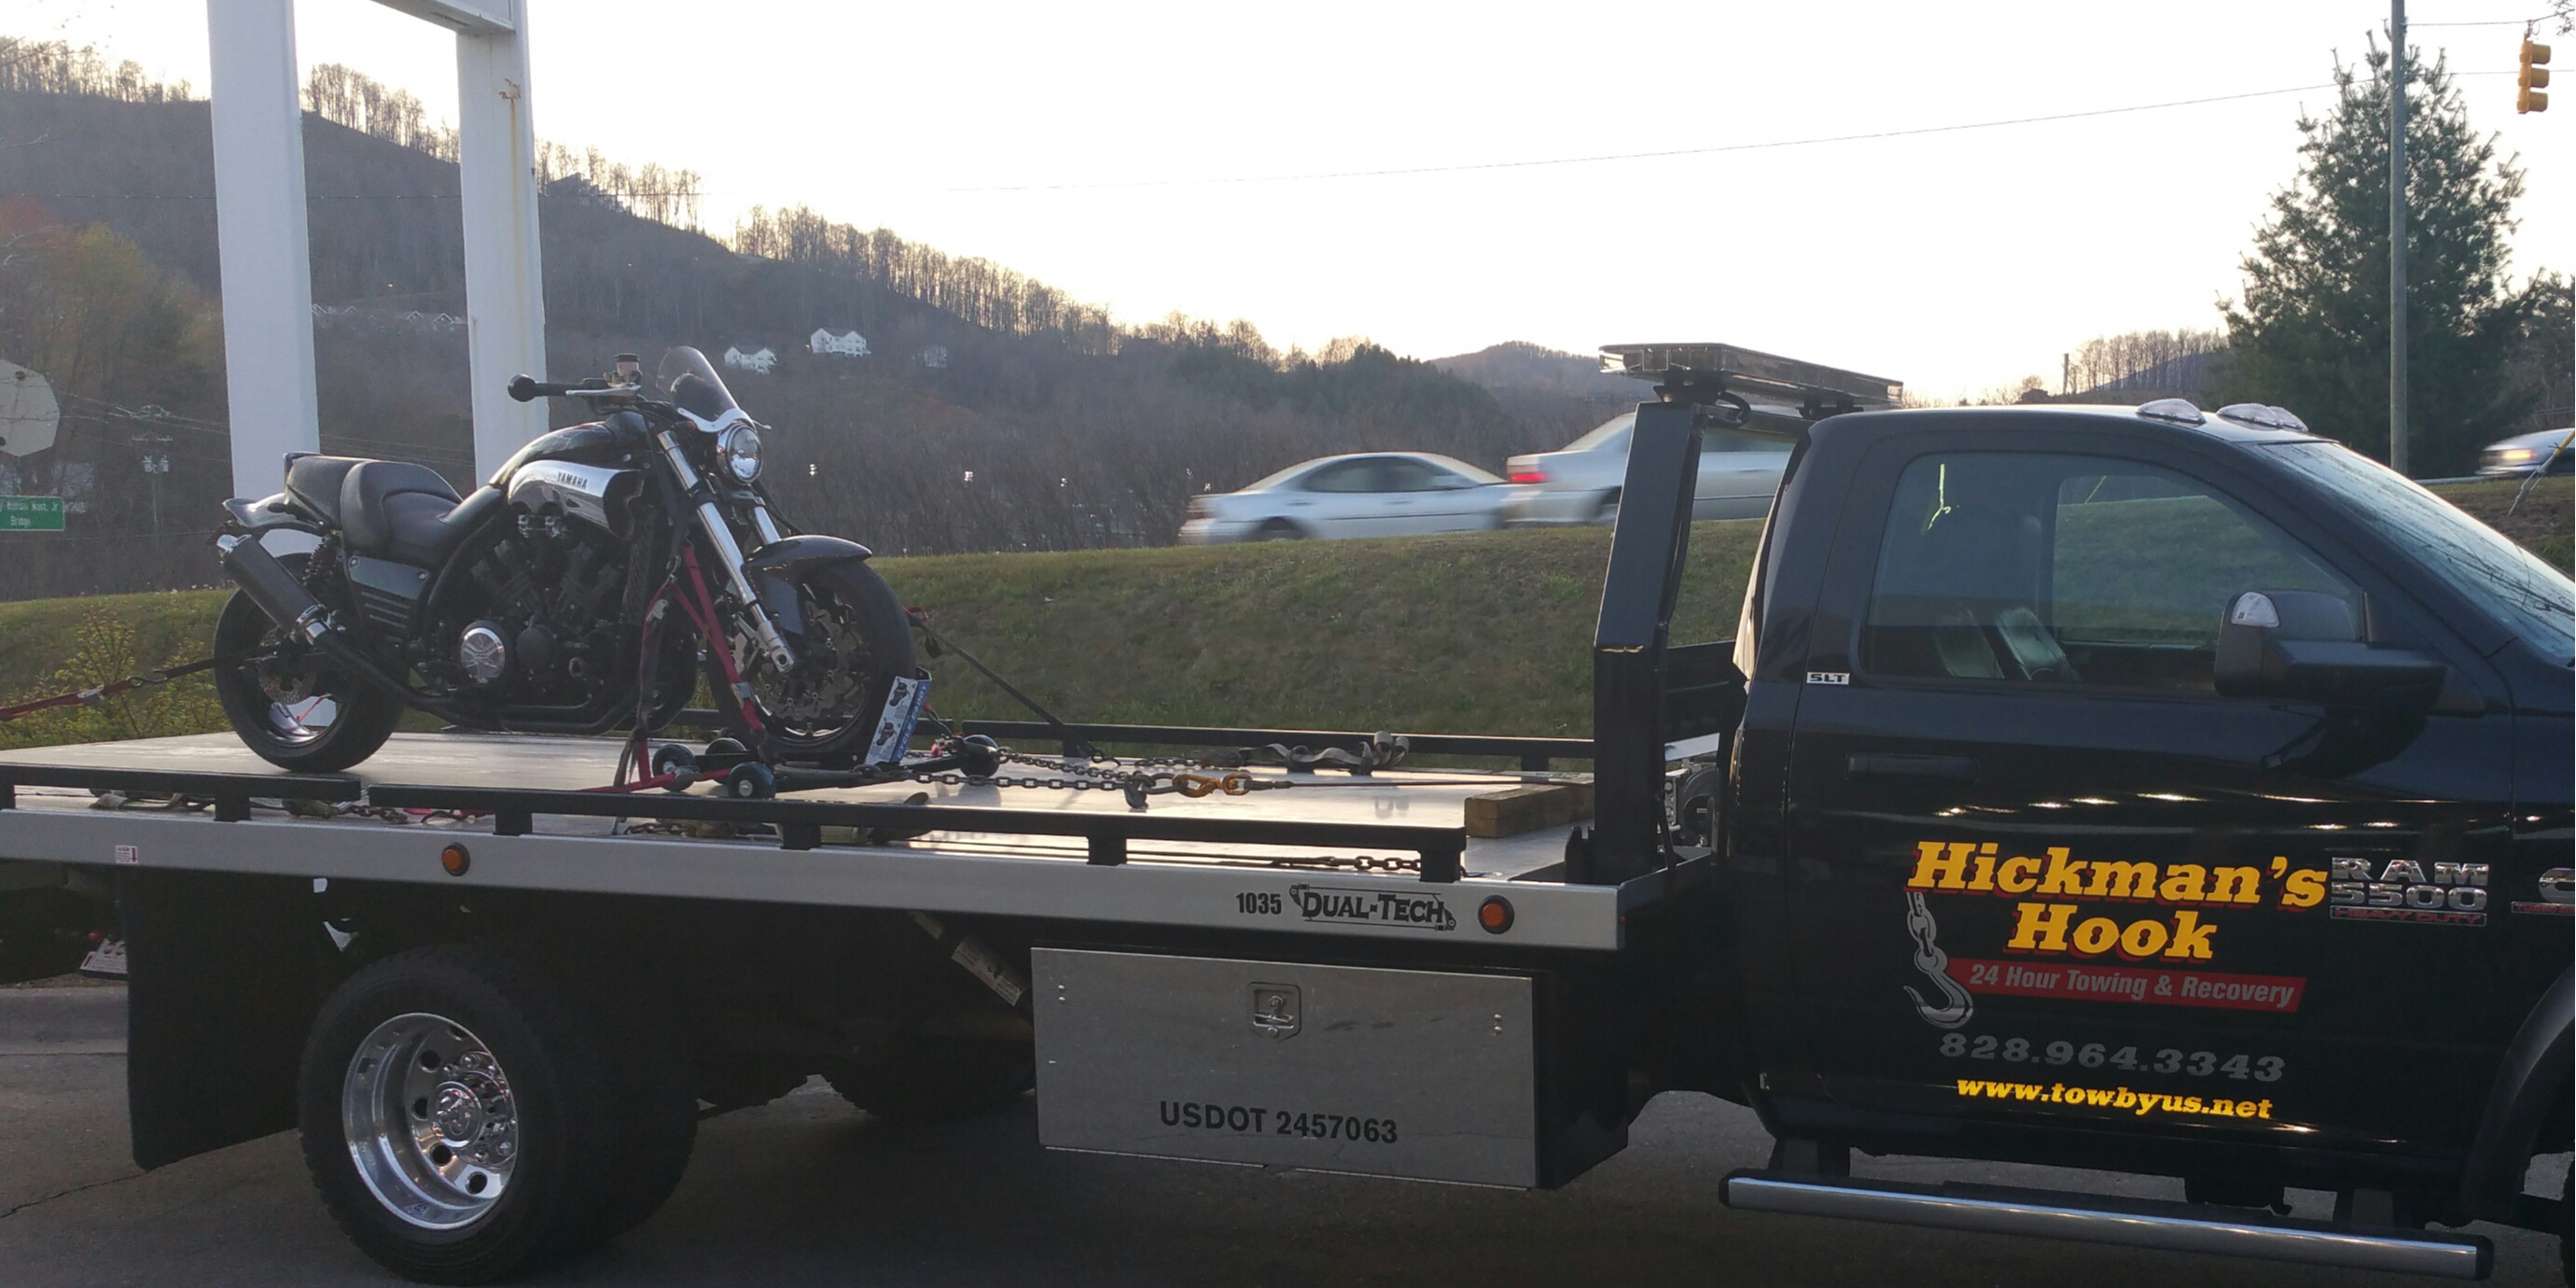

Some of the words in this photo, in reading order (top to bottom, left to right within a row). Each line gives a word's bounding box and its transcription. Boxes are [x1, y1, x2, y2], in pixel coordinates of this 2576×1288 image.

[557, 470, 588, 490] YAMAHA
[1810, 673, 1845, 682] SLT
[897, 722, 913, 759] CYCLE
[911, 685, 927, 721] CADDY
[1905, 841, 2328, 910] Hickman's
[2332, 857, 2489, 886] RAM
[1235, 892, 1282, 915] 1035
[2331, 882, 2487, 911] 5500
[2334, 907, 2412, 921] HEAVY
[2415, 912, 2482, 924] DUTY
[2005, 902, 2218, 961] Hook
[1969, 964, 1998, 986] 24
[2005, 965, 2060, 990] Hour
[2068, 969, 2148, 1001] Towing
[2154, 974, 2173, 997] &
[2180, 976, 2295, 1007] Recovery
[1939, 1032, 2286, 1083] 828.964.3343
[1956, 1079, 2273, 1119] www.towbyus.net
[1160, 1100, 1267, 1133] USDOT
[1275, 1111, 1398, 1143] 2457063
